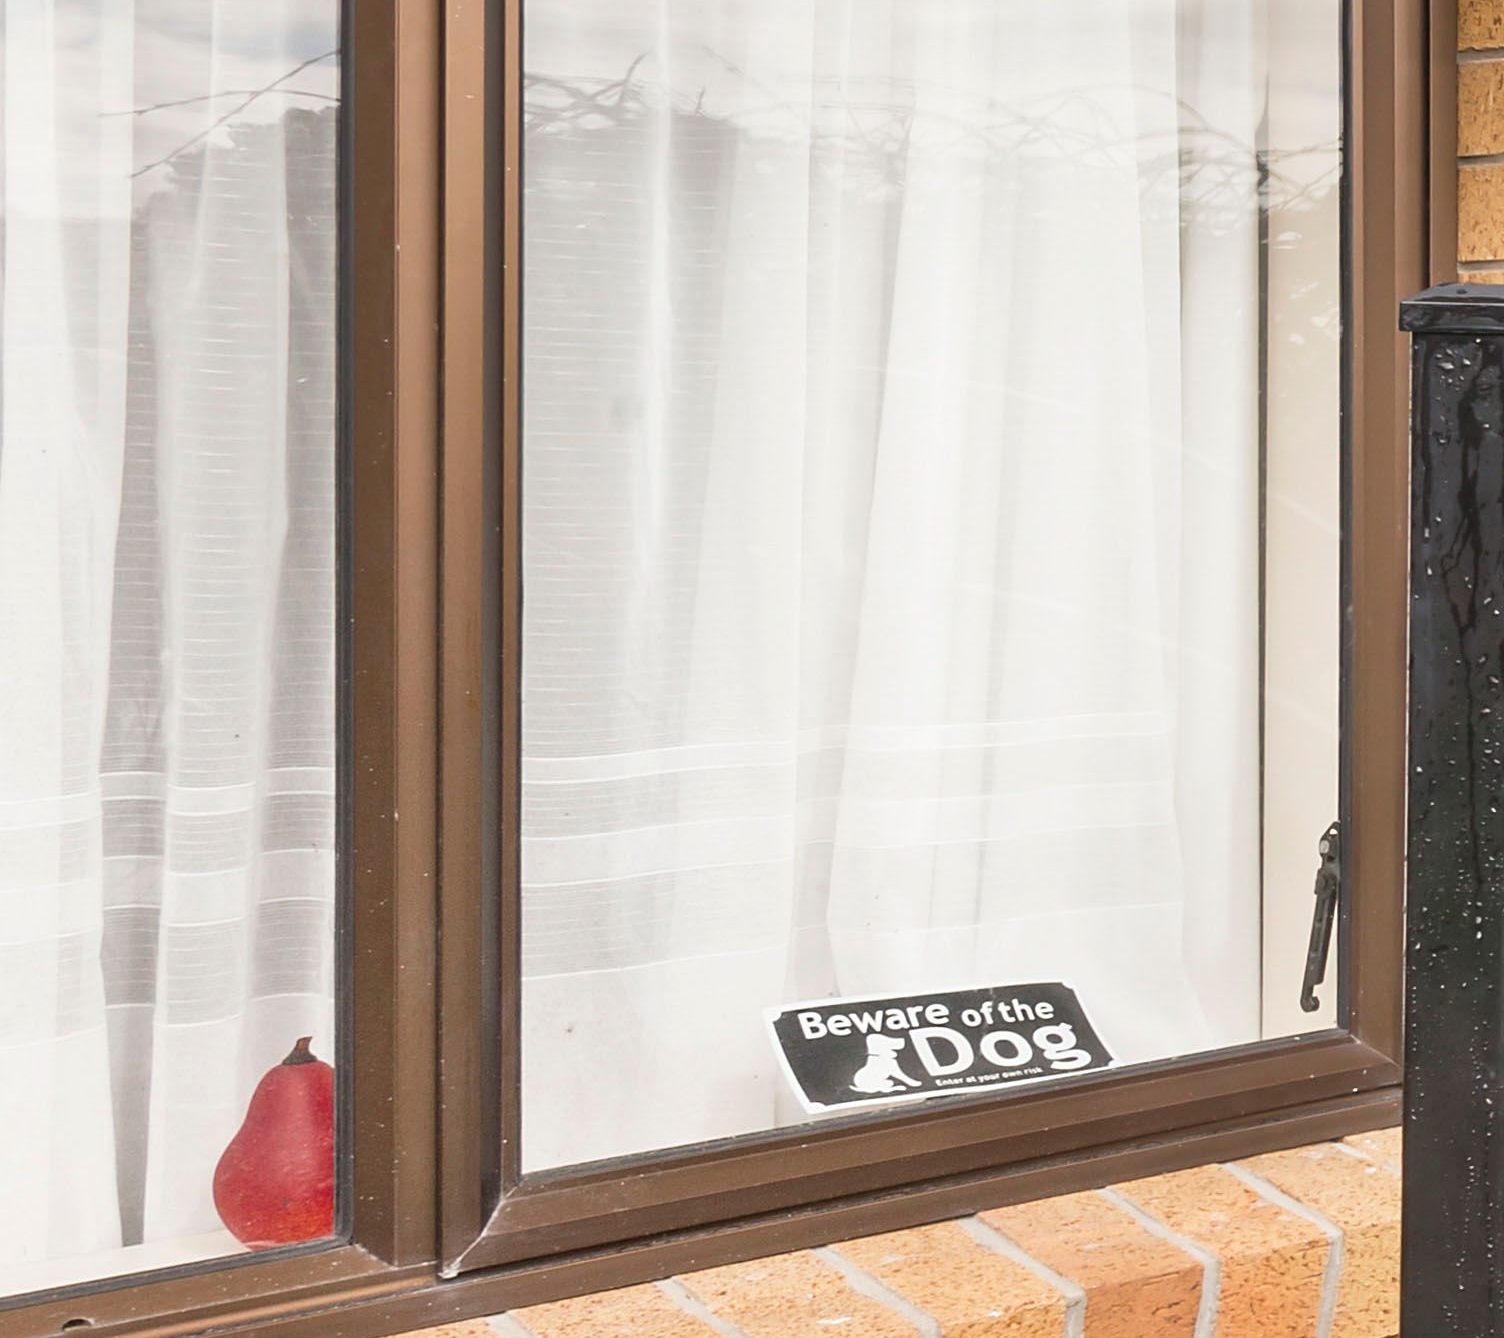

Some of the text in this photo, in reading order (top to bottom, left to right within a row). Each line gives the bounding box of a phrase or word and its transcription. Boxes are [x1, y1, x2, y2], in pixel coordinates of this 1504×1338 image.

[797, 998, 1055, 1040] Beware of the
[908, 1022, 1092, 1077] Dog
[935, 1066, 1043, 1087] Enter at your own risk
